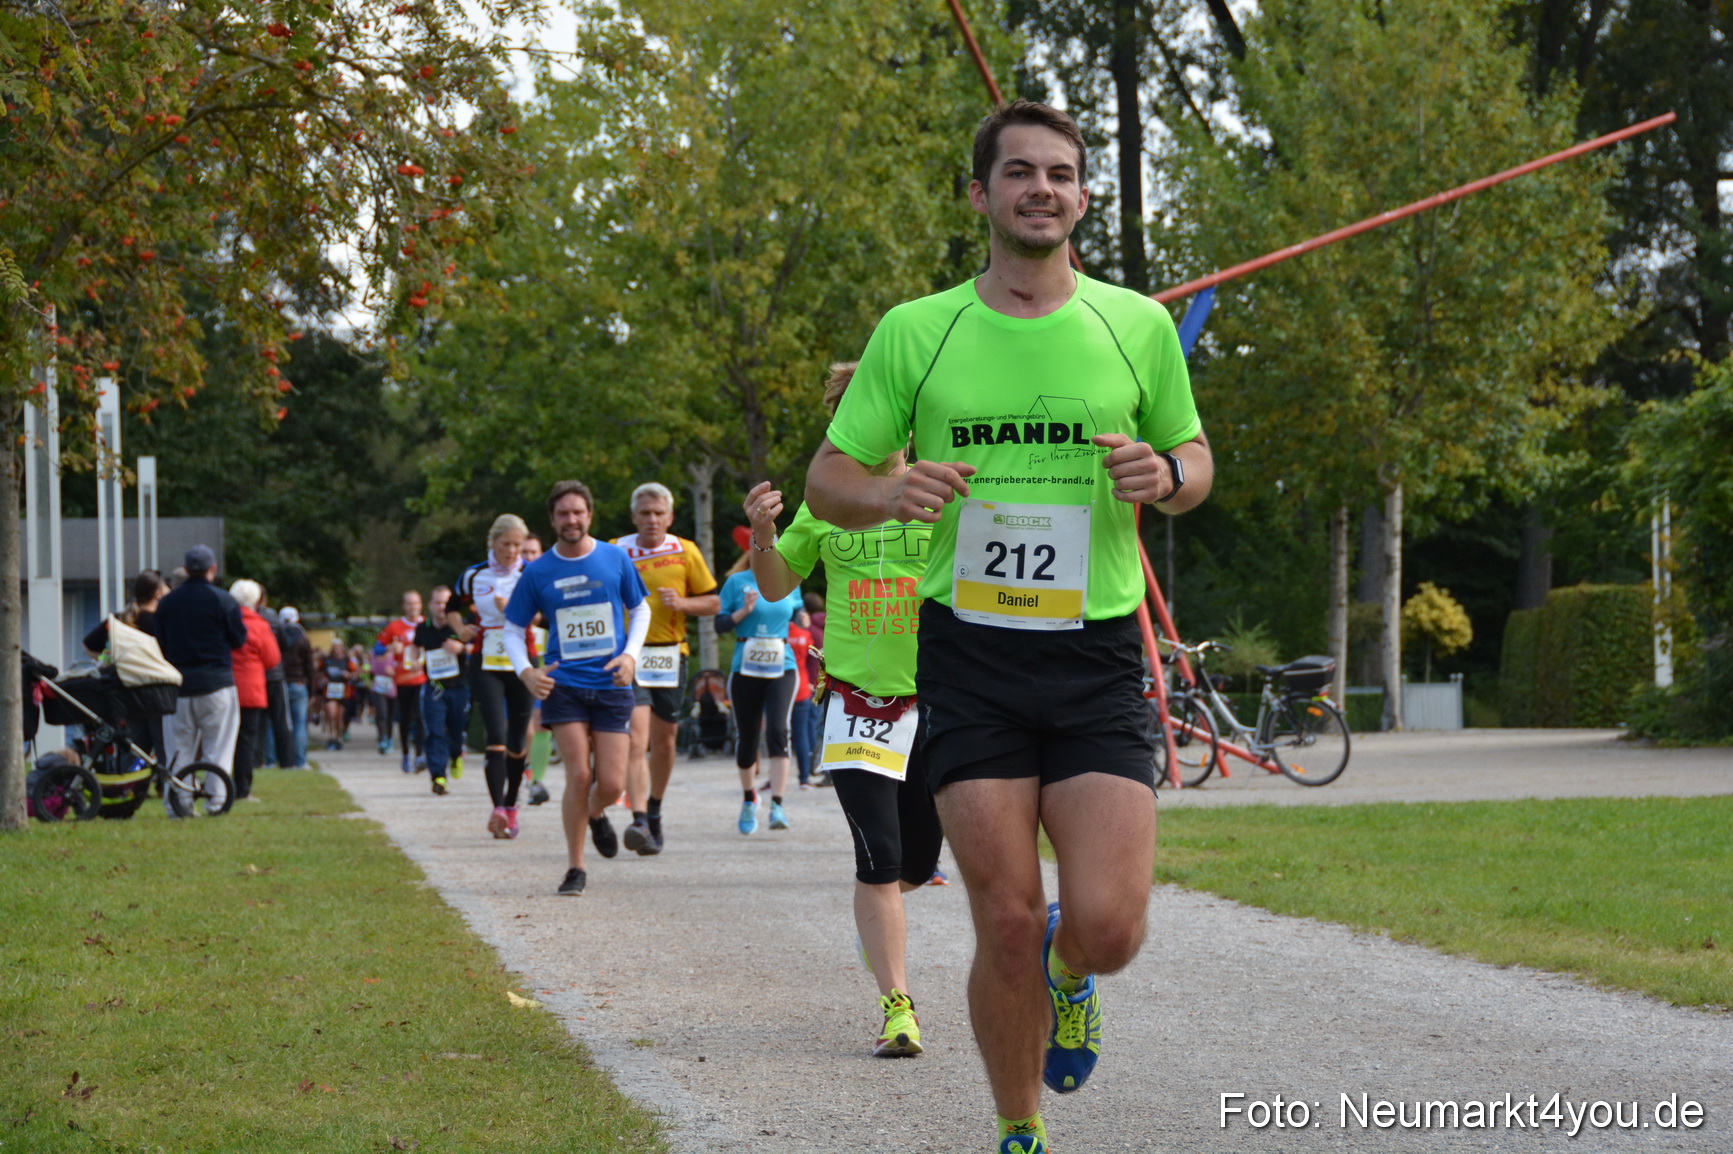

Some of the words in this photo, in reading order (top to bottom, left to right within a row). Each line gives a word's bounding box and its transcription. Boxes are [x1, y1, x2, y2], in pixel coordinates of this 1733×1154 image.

[951, 422, 1090, 448] BRANDL
[1028, 453, 1047, 470] für
[1050, 450, 1070, 462] Ihre
[1074, 447, 1108, 458] Zukun
[963, 475, 1095, 486] w.energieberater-brandl.de
[1005, 514, 1052, 527] BOCK
[984, 540, 1056, 581] 212
[848, 576, 923, 600] MER
[849, 599, 923, 618] PREMIU
[997, 591, 1039, 608] Daniel
[566, 619, 606, 639] 2150
[850, 618, 919, 635] REISE
[641, 656, 673, 669] 2628
[749, 649, 779, 663] 2237
[846, 715, 894, 744] 132
[845, 745, 881, 760] Andreas
